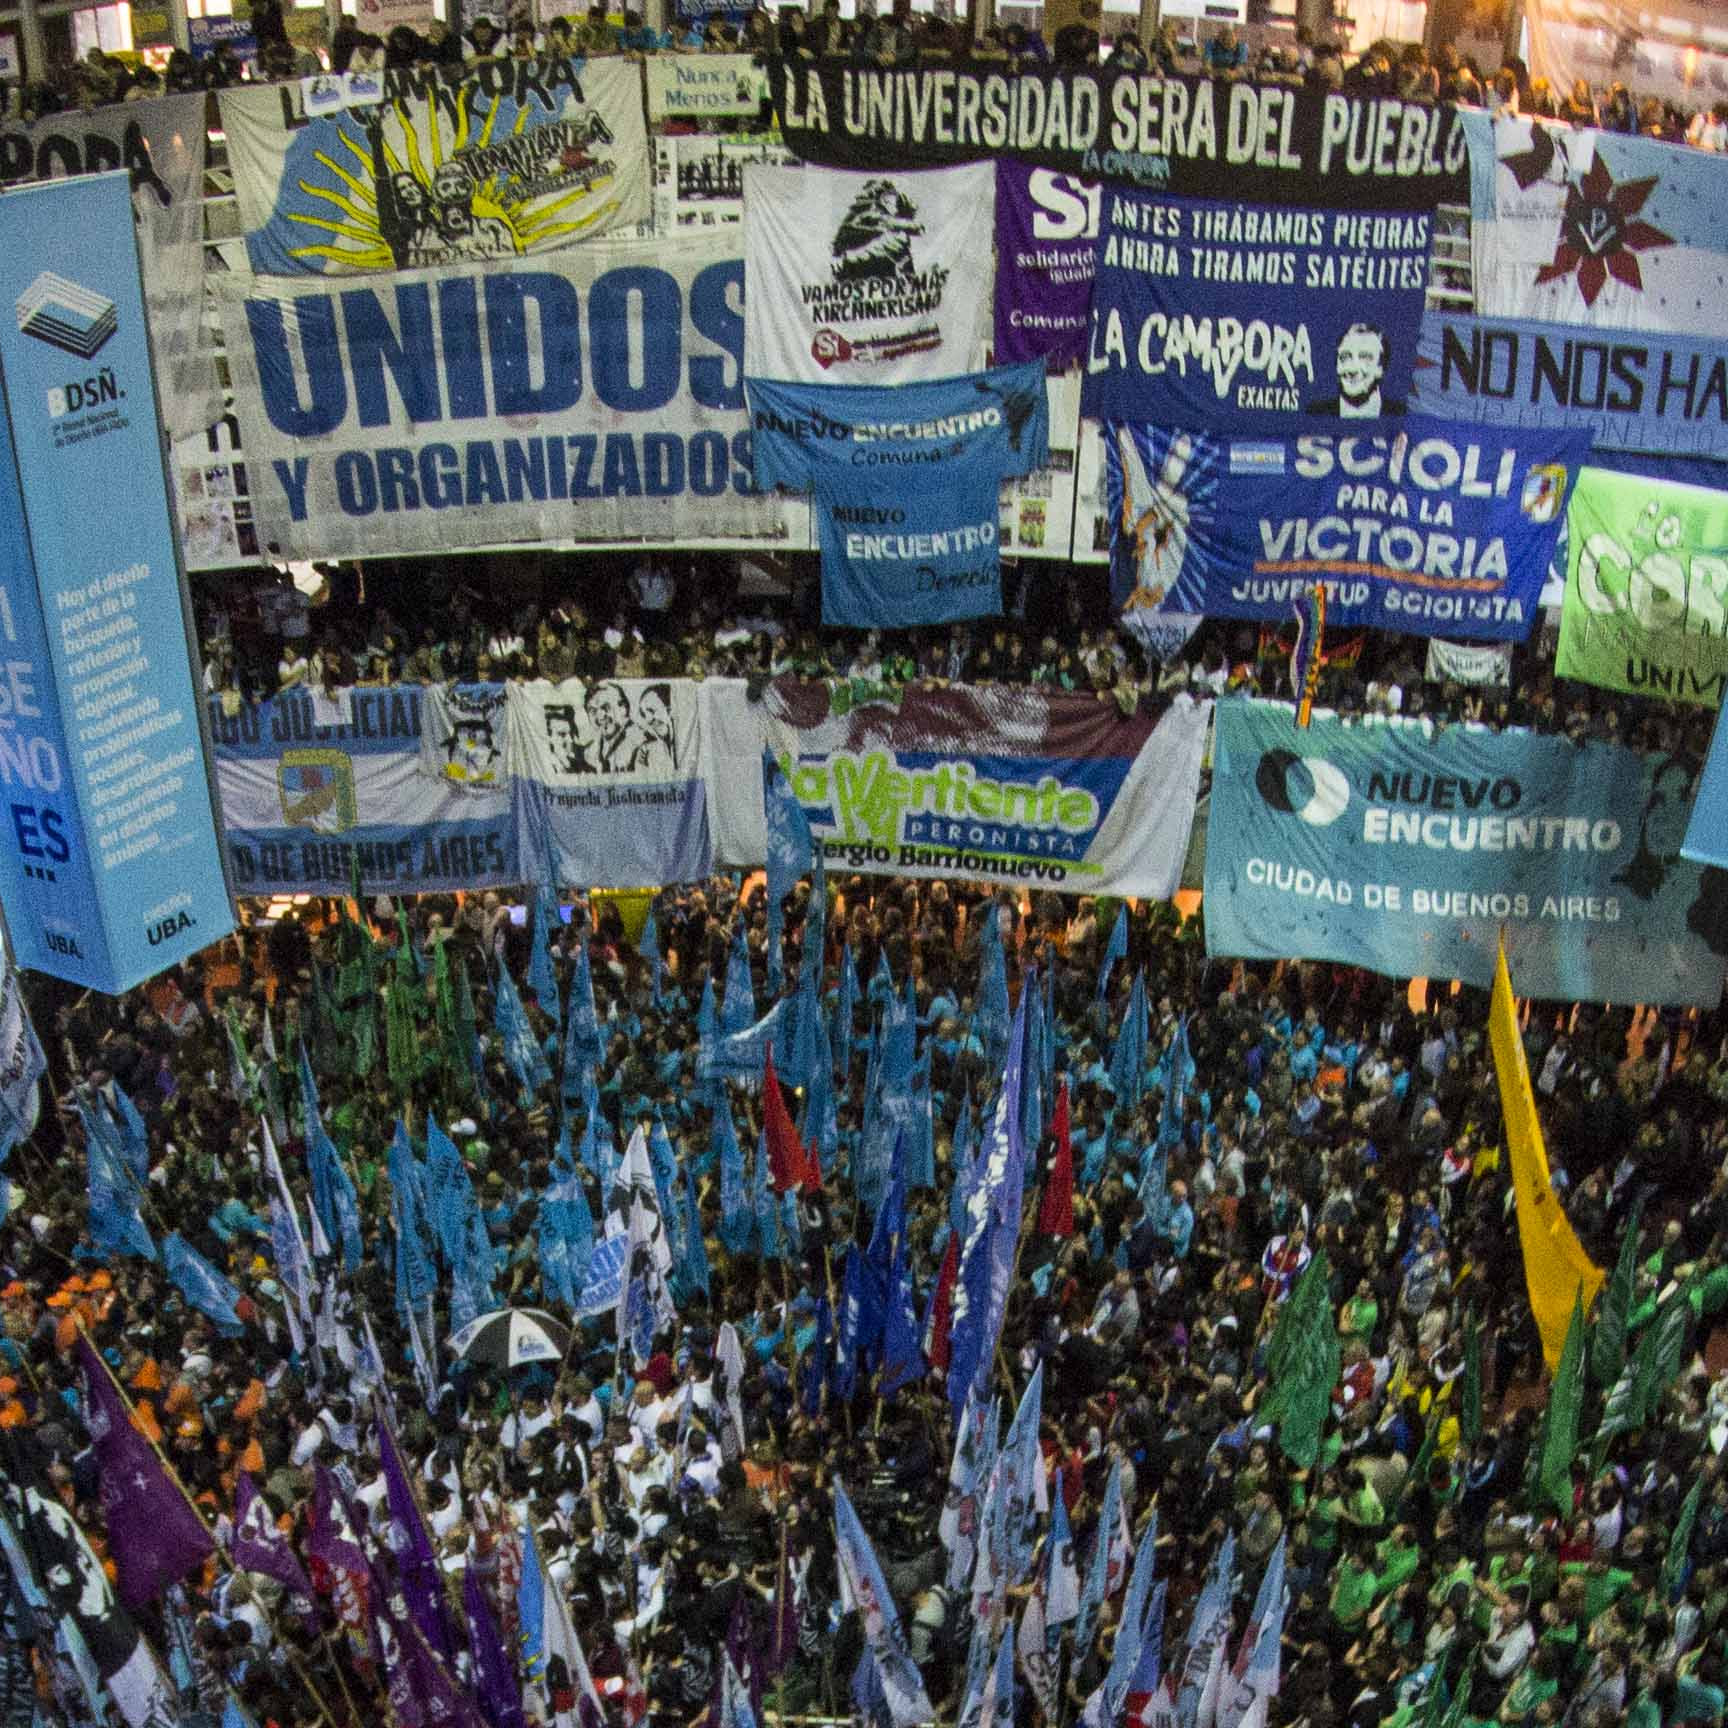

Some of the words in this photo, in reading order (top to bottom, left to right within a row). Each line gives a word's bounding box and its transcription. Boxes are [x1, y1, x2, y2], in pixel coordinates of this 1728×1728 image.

[784, 66, 827, 131] LA
[843, 66, 1100, 150] UNIVERSIDAD
[1109, 76, 1218, 158] SERA
[1226, 88, 1301, 170] DEL
[1319, 93, 1469, 177] PUEBLO
[1110, 197, 1180, 236] ANTES
[1191, 203, 1325, 244] TIRÁBAMOS
[1333, 212, 1429, 251] PIEDRAS
[1104, 235, 1180, 279] AHORA
[1189, 249, 1298, 286] TIRAMOS
[1304, 246, 1426, 291] SATÉLITES
[800, 280, 865, 306] VAMOS
[867, 277, 908, 300] POR
[246, 259, 745, 438] UNIDOS
[1088, 309, 1127, 374] LA
[1438, 324, 1519, 401] NO
[1528, 338, 1648, 415] NOS
[852, 406, 1003, 442] ENCUENTRO
[274, 455, 310, 523] Y
[333, 428, 757, 518] ORGANIZADOS
[1294, 431, 1515, 500] SCIOLI
[1336, 484, 1408, 514] PARA
[1417, 492, 1455, 528] LA
[846, 522, 996, 560] ENCUENTRO
[1258, 516, 1510, 581] VICTORIA
[1362, 771, 1522, 810] NUEVO
[1364, 808, 1624, 855] ENCUENTRO
[898, 845, 1068, 882] Barrionuevo
[1245, 859, 1353, 908] CIUDAD
[1363, 886, 1404, 913] DE
[1412, 888, 1533, 922] BUENOS
[1540, 892, 1621, 924] AIRES
